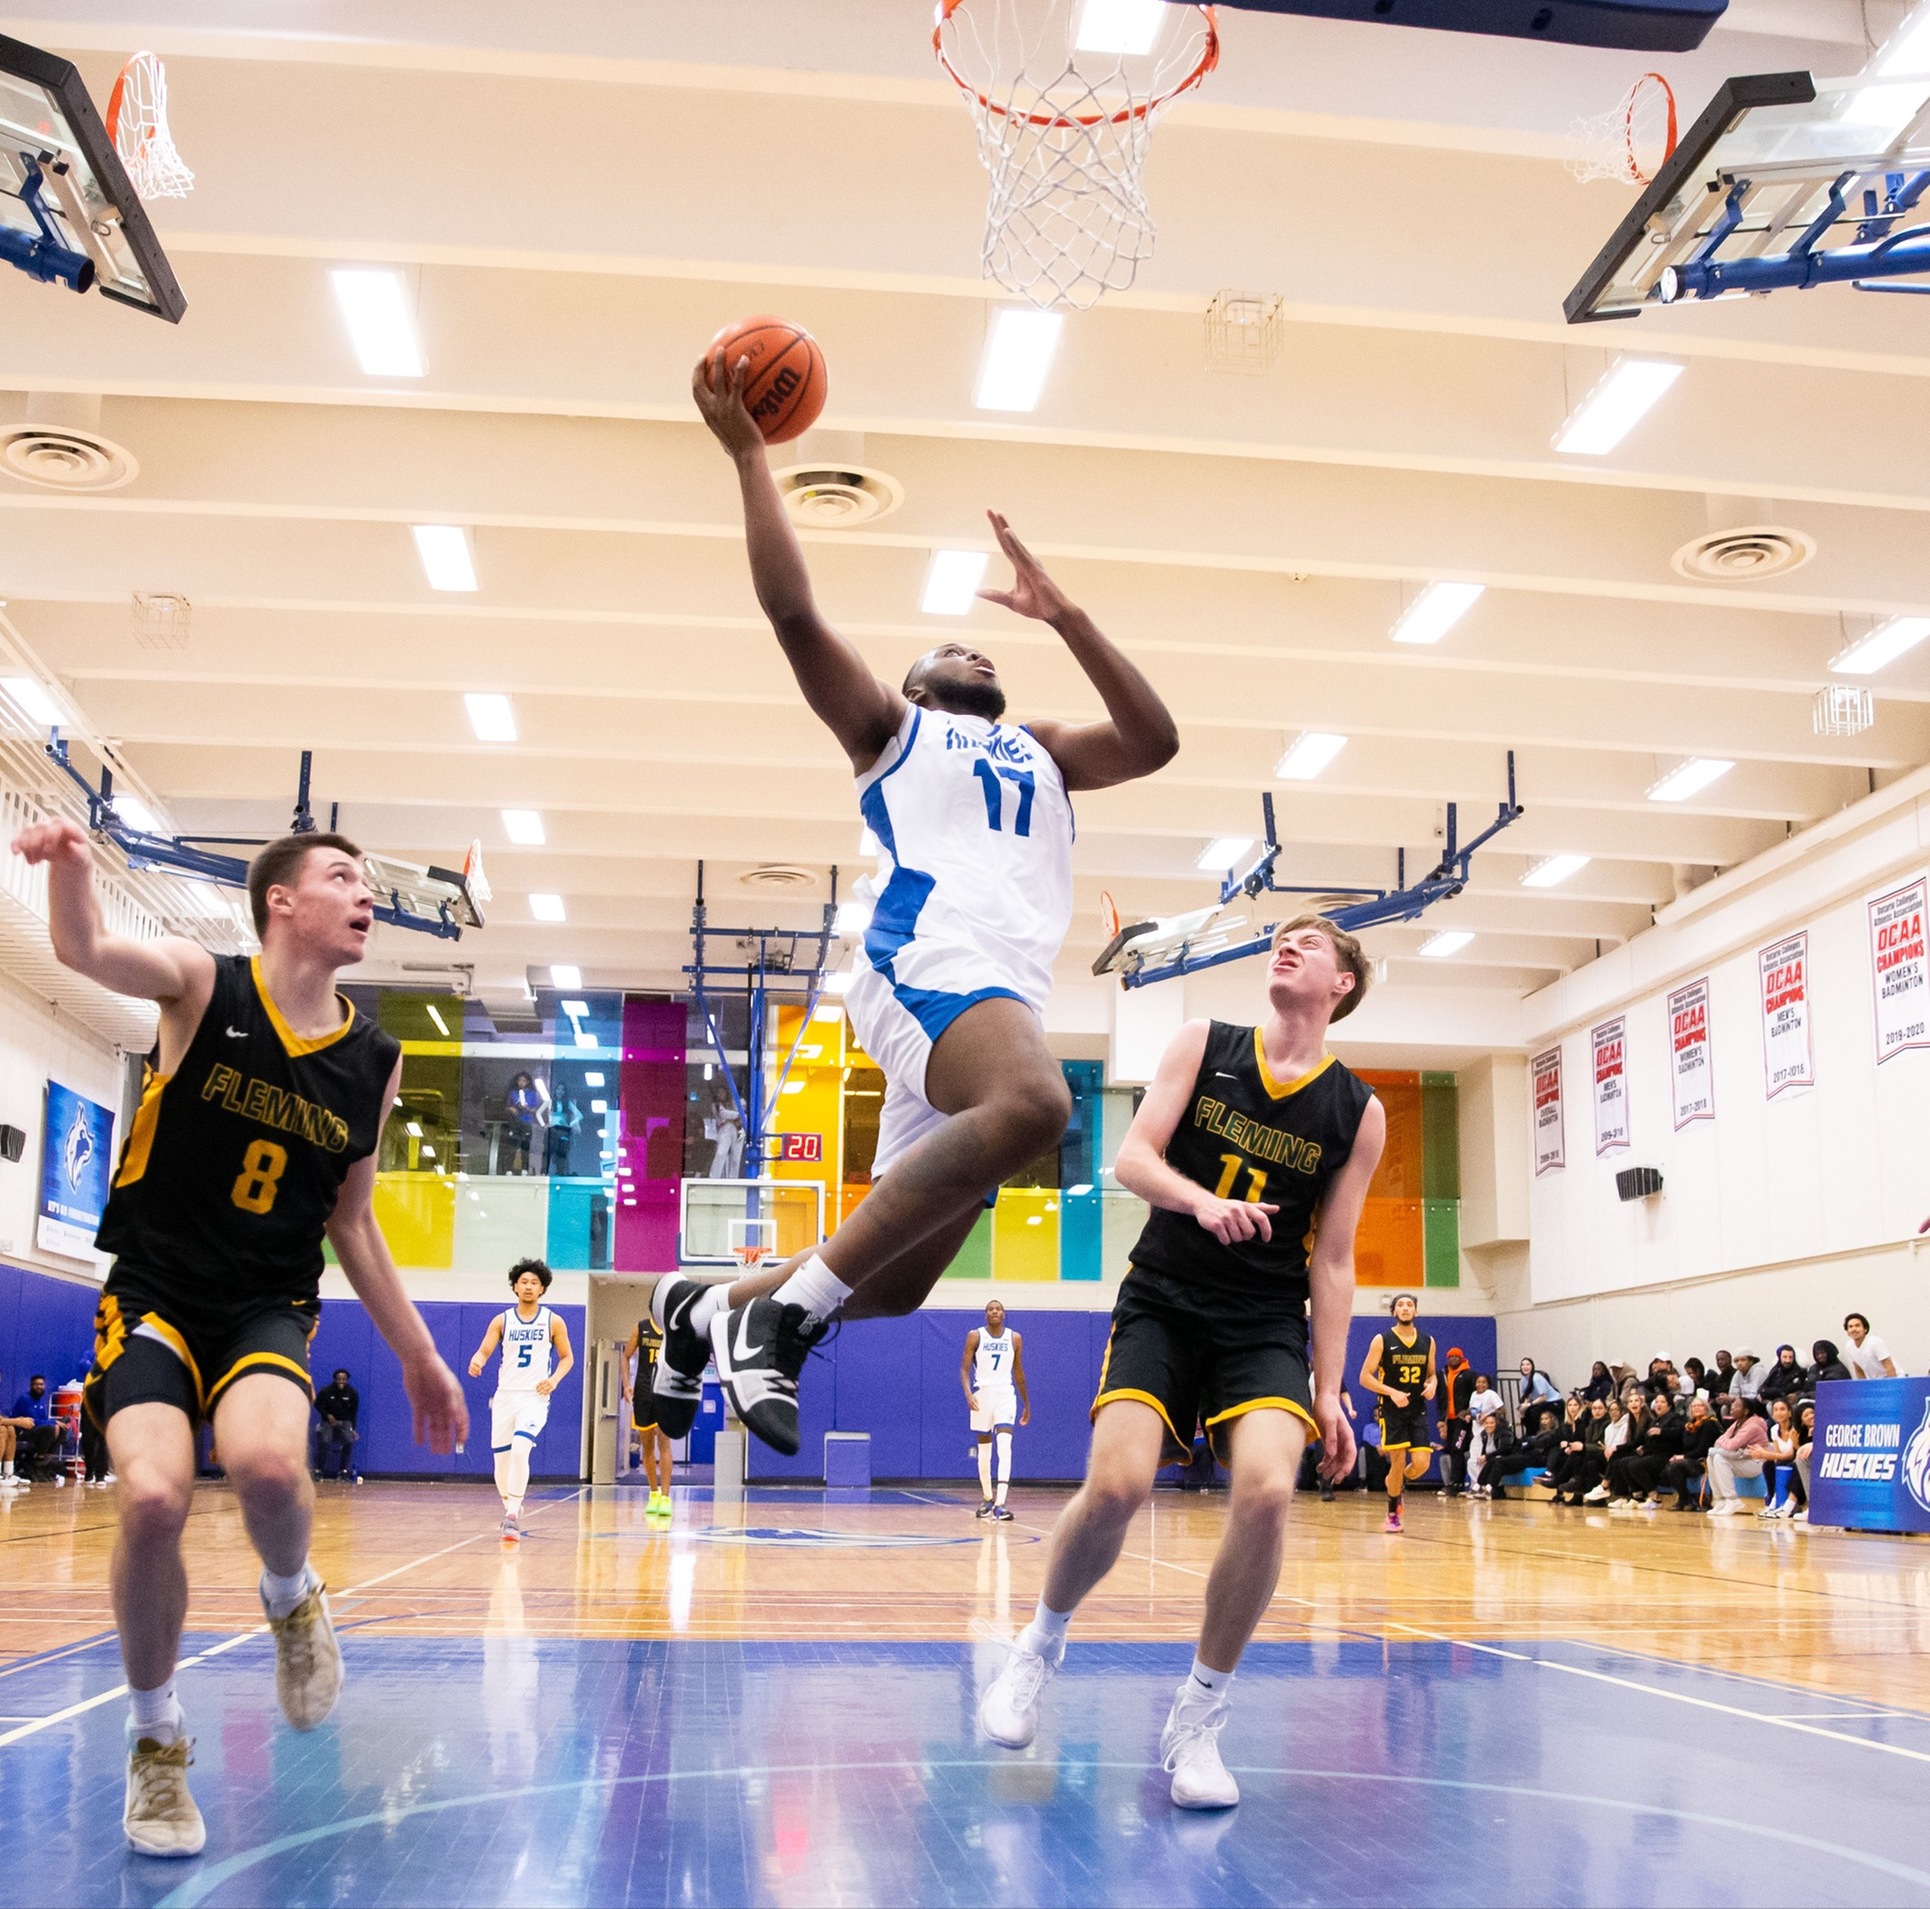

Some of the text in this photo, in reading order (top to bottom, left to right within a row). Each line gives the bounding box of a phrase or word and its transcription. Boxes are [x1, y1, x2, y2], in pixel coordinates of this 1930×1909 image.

[972, 758, 1035, 838] 17
[1878, 914, 1921, 951] OCAA
[1877, 938, 1924, 973] CHAMPIONS
[1766, 961, 1802, 995] OCAA
[1884, 962, 1919, 984] WOMEN'S
[1882, 974, 1923, 999] BADMINTON
[1765, 984, 1804, 1015] CHAMPIONS
[1674, 1004, 1705, 1035] OCAA
[1777, 1007, 1795, 1023] MEN'S
[1674, 1026, 1706, 1053] CHAMPIONS
[1771, 1017, 1802, 1038] BADMINTON
[1886, 1022, 1925, 1045] 2019-2020
[1596, 1040, 1622, 1067] OCAA
[1679, 1045, 1702, 1063] WOMEN'S
[1678, 1057, 1704, 1075] BADMINTON
[1773, 1063, 1805, 1083] 2017-2018
[201, 1062, 350, 1154] FLEMING
[1680, 1098, 1707, 1117] 2017-2018
[788, 1135, 818, 1158] 20
[1193, 1095, 1322, 1175] FLEMING
[230, 1139, 289, 1215] 8
[1214, 1153, 1268, 1204] 11
[508, 1329, 545, 1341] HUSKIES
[982, 1342, 1009, 1352] HUSKIES
[517, 1344, 533, 1368] 5
[991, 1354, 1001, 1371] 7
[1399, 1366, 1421, 1384] 32
[1825, 1424, 1900, 1447] GEORGE BROWN
[1819, 1453, 1898, 1480] HUSKIES
